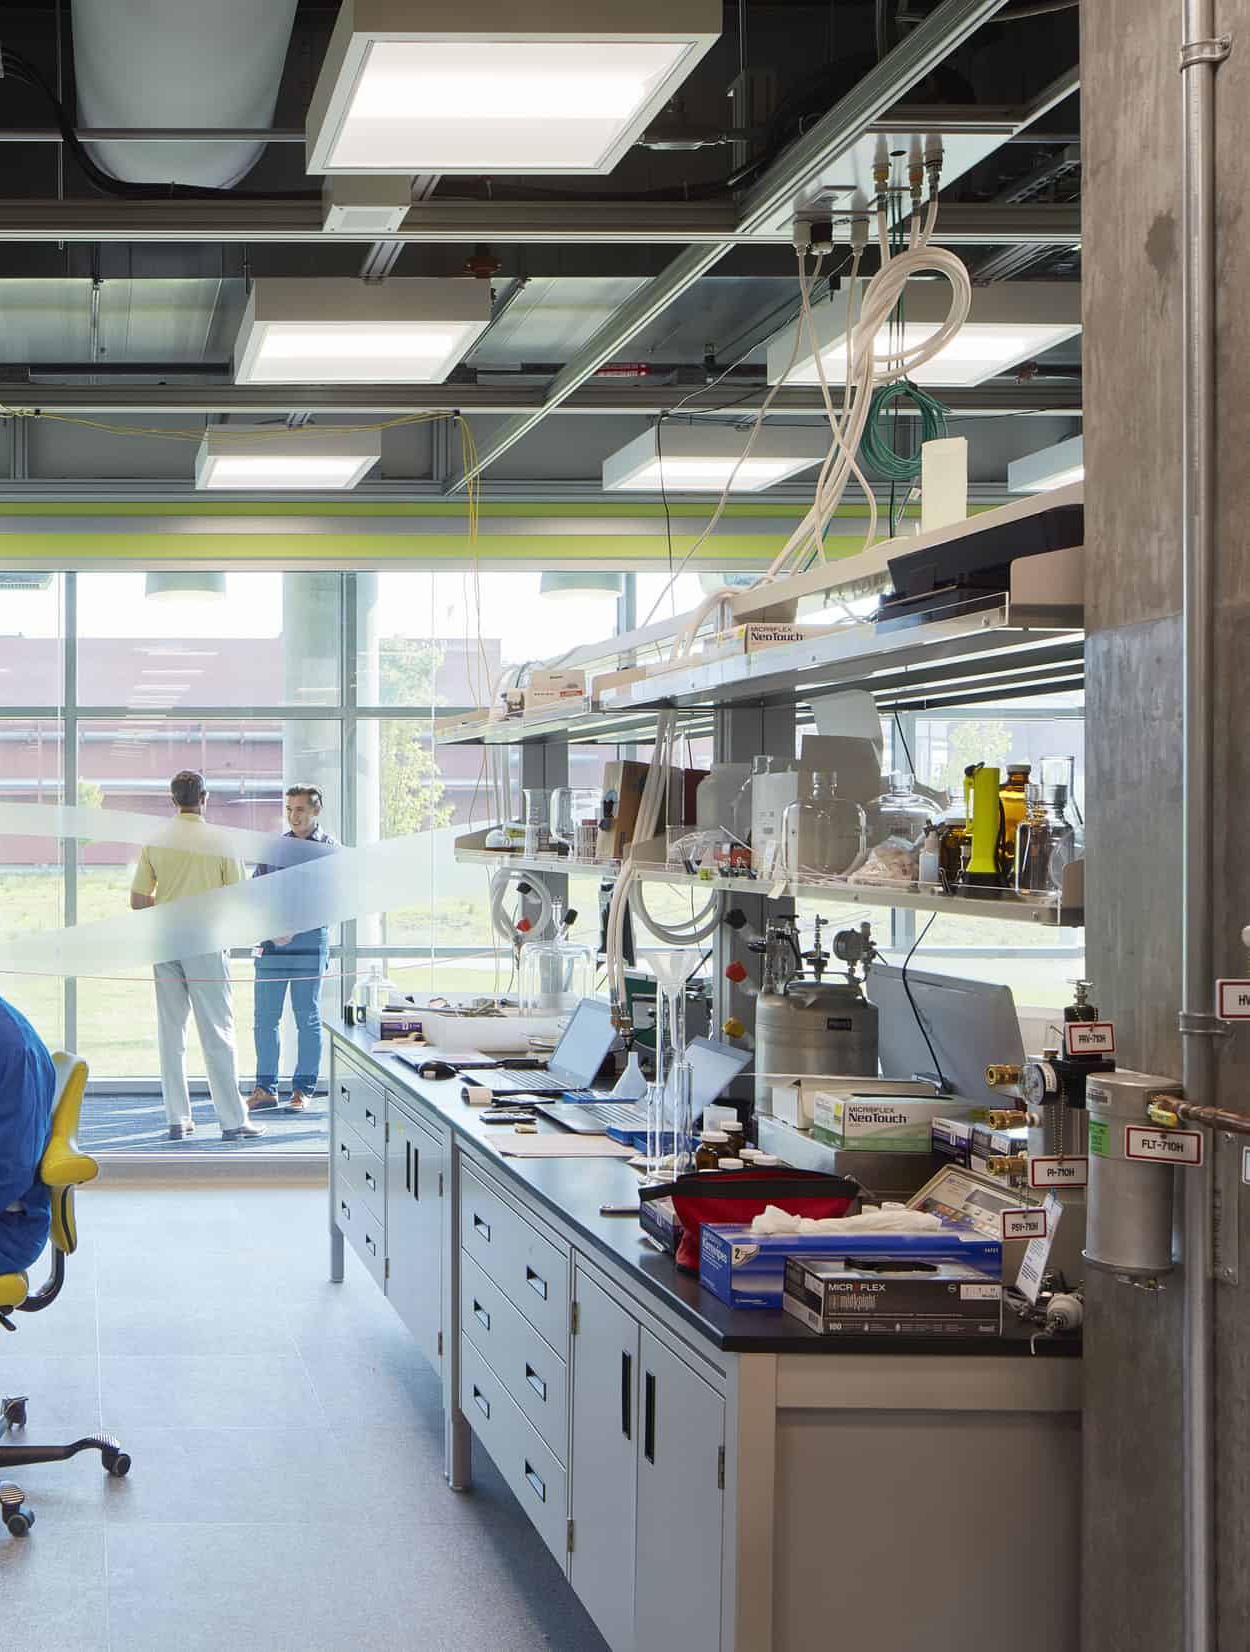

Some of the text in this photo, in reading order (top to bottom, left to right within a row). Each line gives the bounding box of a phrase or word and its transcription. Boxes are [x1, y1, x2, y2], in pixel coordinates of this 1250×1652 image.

[751, 632, 803, 641] NeoTouch
[848, 1106, 894, 1114] MICROFLEX
[848, 1113, 907, 1124] NeoTouch
[1141, 1139, 1183, 1153] FLT-710H
[1047, 1168, 1075, 1178] PI-710H
[1011, 1222, 1038, 1233] PSV-710H
